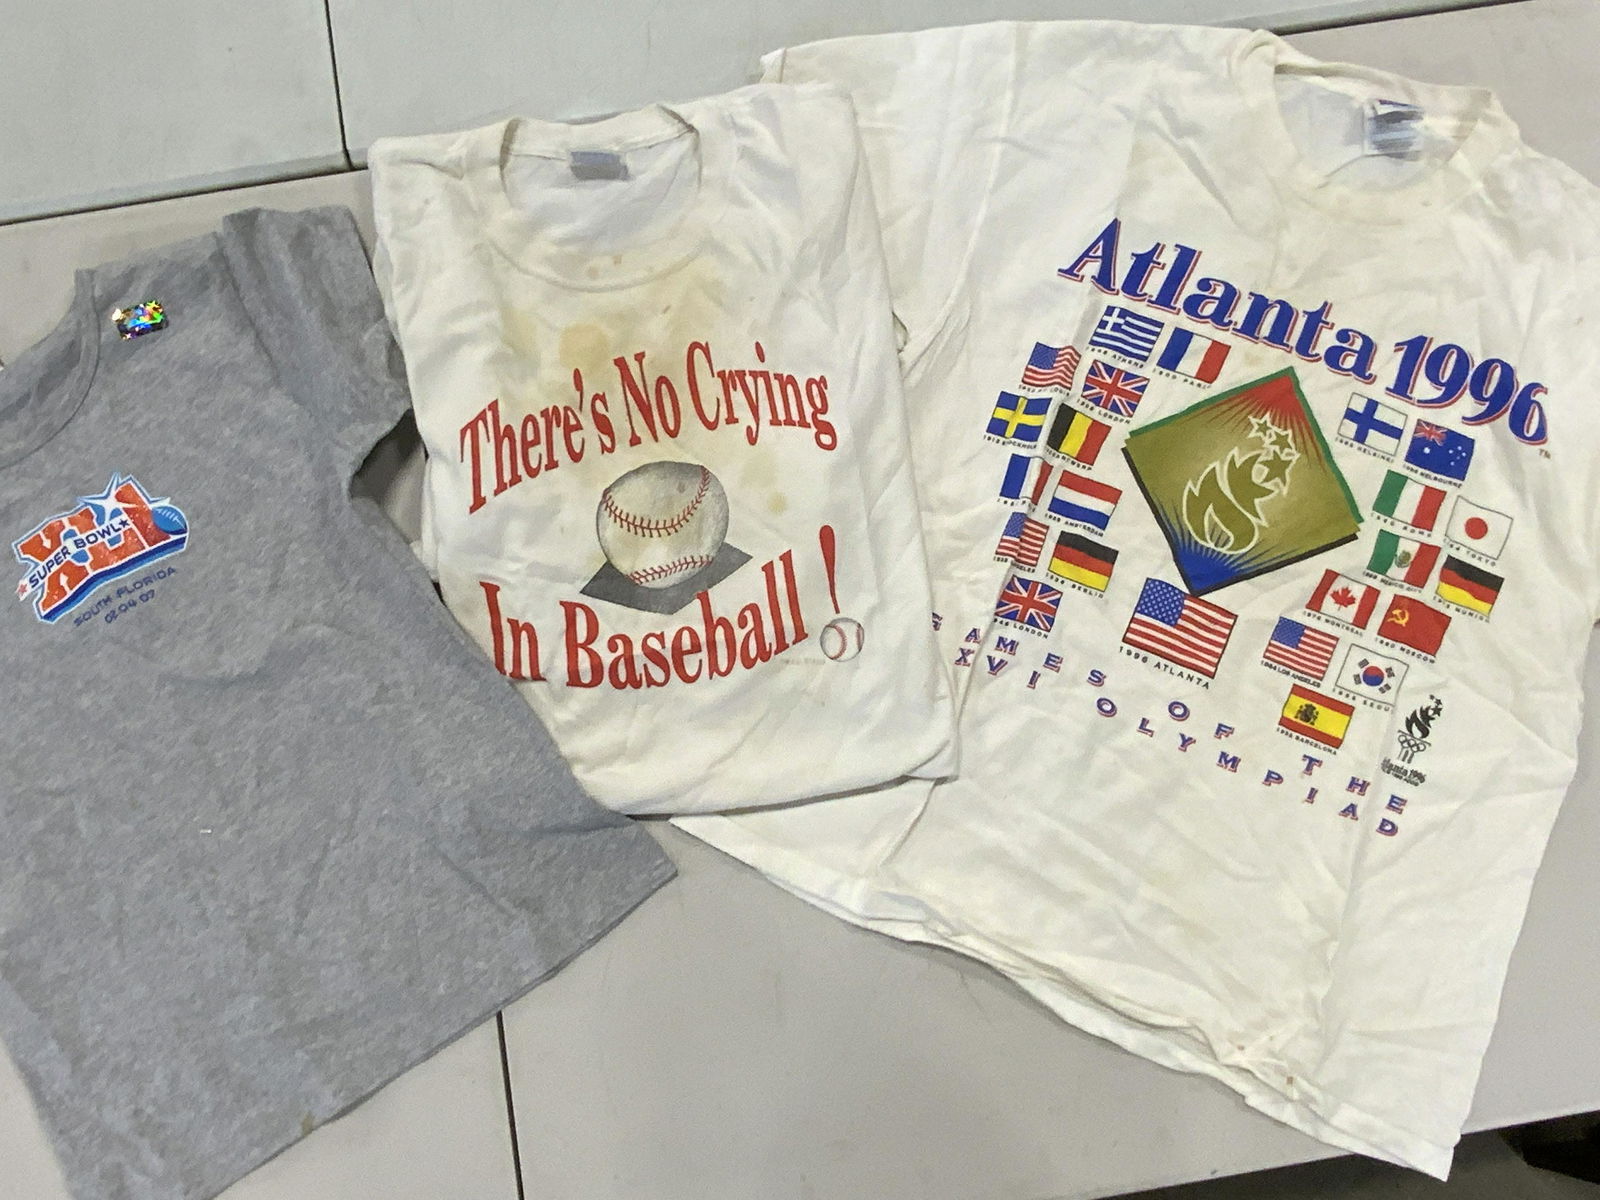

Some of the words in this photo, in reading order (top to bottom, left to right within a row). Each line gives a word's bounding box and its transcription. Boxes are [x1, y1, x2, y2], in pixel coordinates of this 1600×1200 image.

[1058, 217, 1378, 385] Atlanta
[1385, 333, 1551, 446] 1996
[460, 367, 615, 515] There's
[613, 351, 681, 447] No
[686, 340, 838, 451] Crying
[29, 545, 71, 589] SUPER
[74, 525, 122, 550] BOWL
[74, 594, 113, 627] SOUTH
[116, 566, 176, 598] FLORIDA
[479, 580, 547, 682] In
[1013, 622, 1049, 640] LONDON
[1119, 645, 1149, 664] 1996
[1153, 660, 1210, 690] ATLANTA
[1295, 733, 1338, 755] BARCELONA
